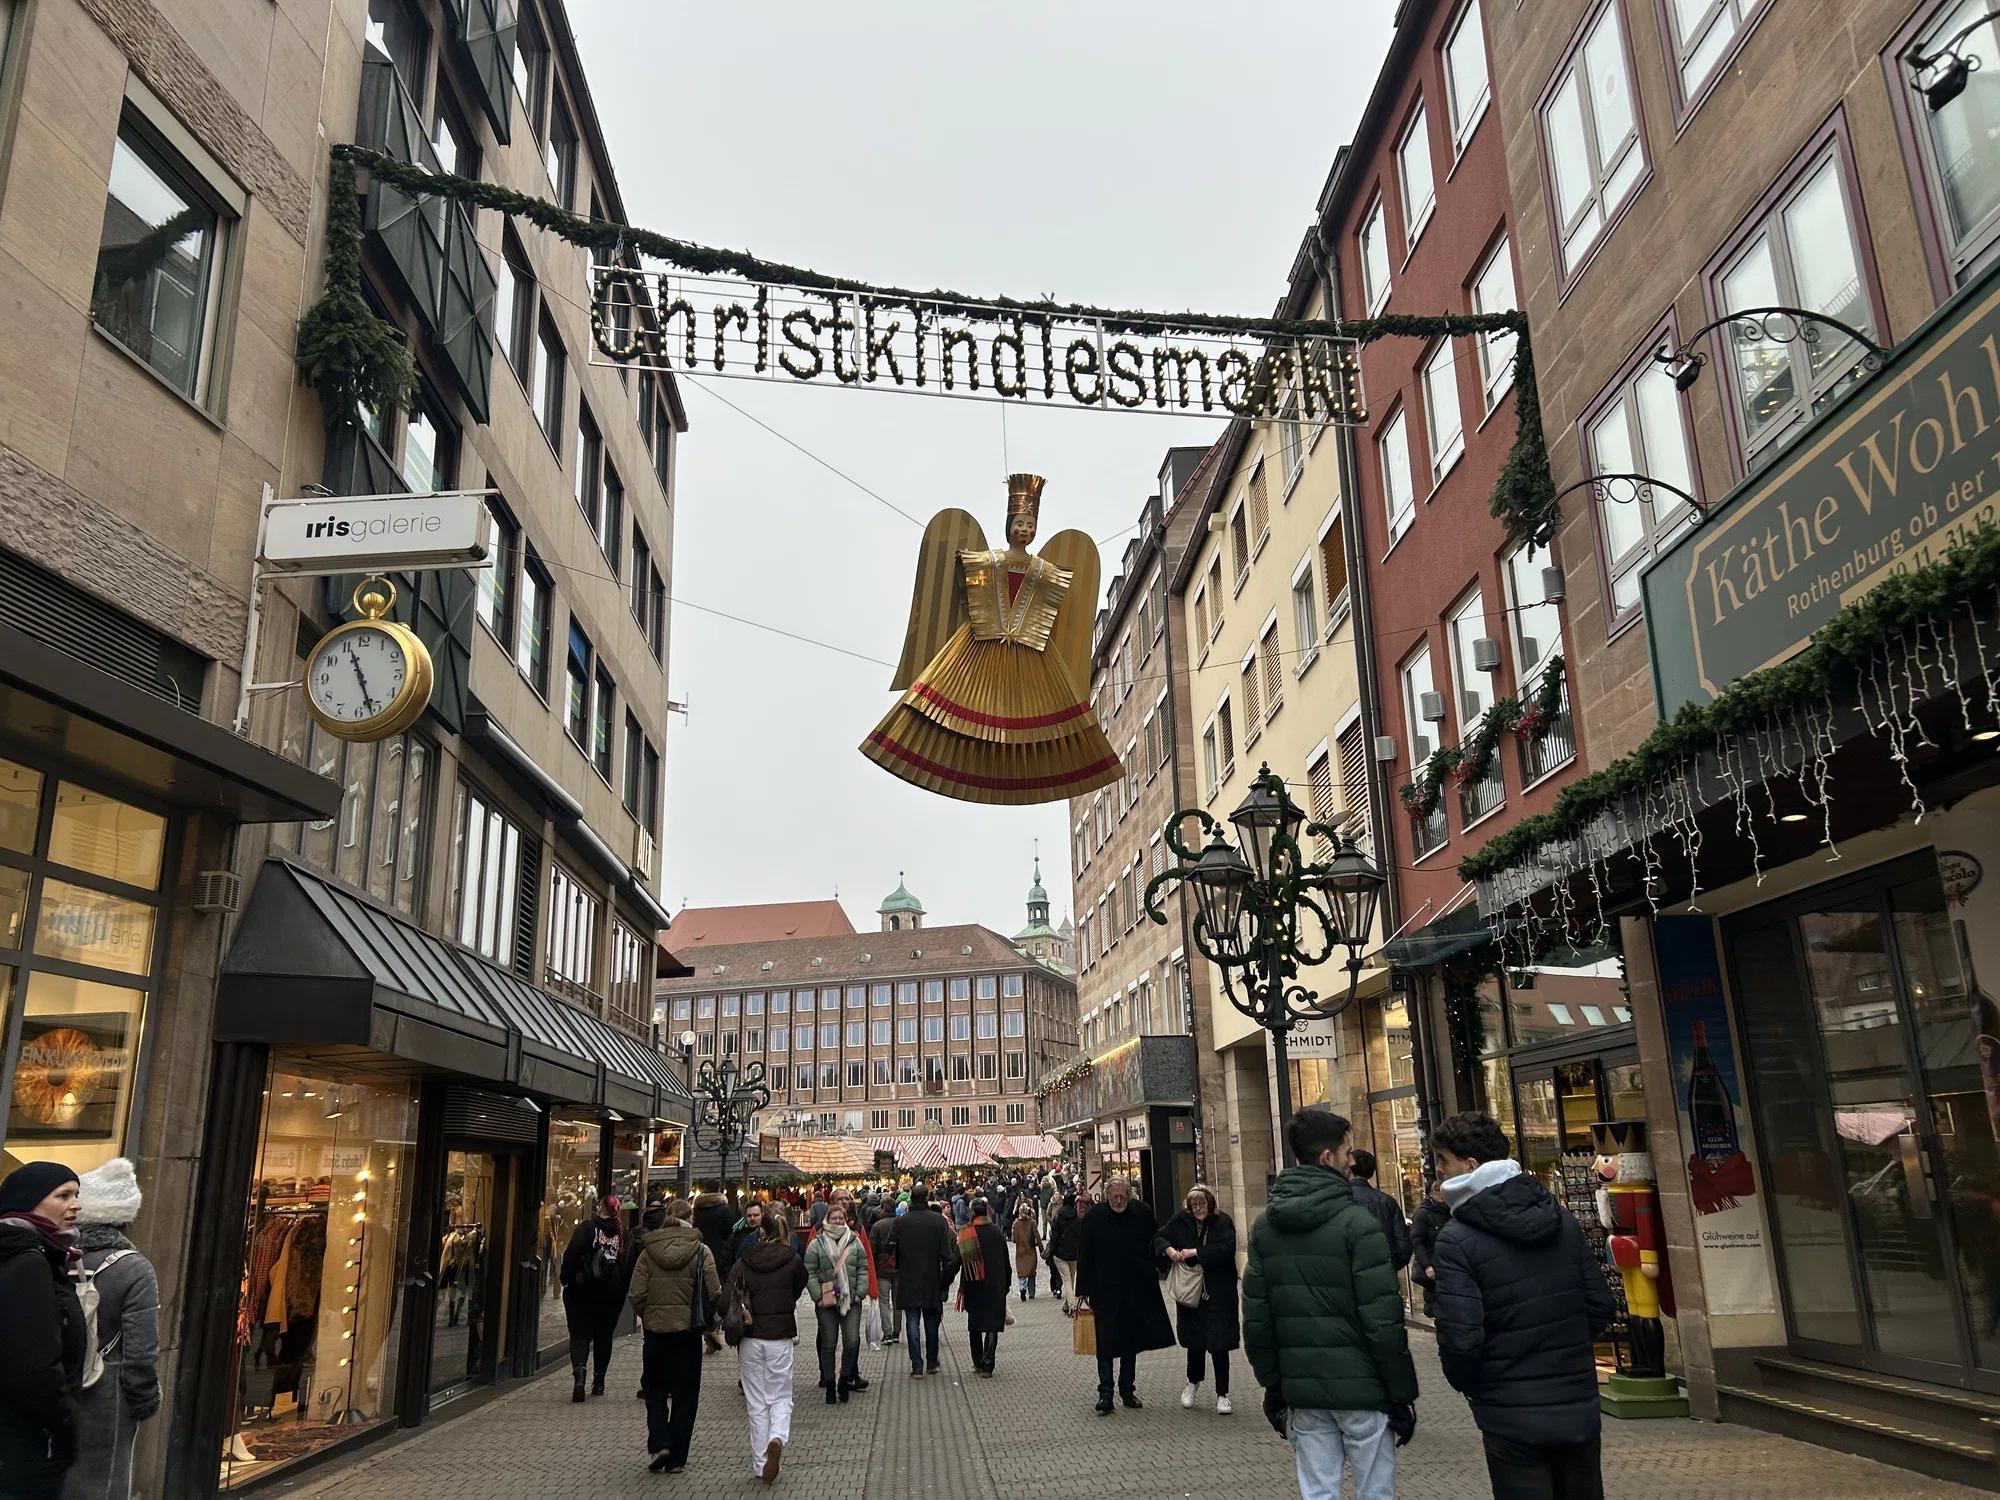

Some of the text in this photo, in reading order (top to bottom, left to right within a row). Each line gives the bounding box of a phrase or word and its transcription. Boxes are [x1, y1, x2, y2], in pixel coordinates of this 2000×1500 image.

[590, 269, 1369, 423] Christkindlesmarkt
[306, 512, 441, 543] irisgalerie
[1787, 470, 1986, 619] Rothenburg ob der
[1705, 496, 1841, 626] Käthe
[358, 633, 371, 648] 12
[380, 639, 385, 651] 1
[342, 641, 352, 653] 11
[327, 655, 338, 667] 10
[390, 651, 399, 663] 2
[321, 673, 330, 685] 9
[324, 690, 333, 703] 8
[387, 687, 396, 699] 4
[336, 703, 345, 715] 7
[354, 707, 364, 719] 6
[1702, 1230, 1744, 1240] Glühweine
